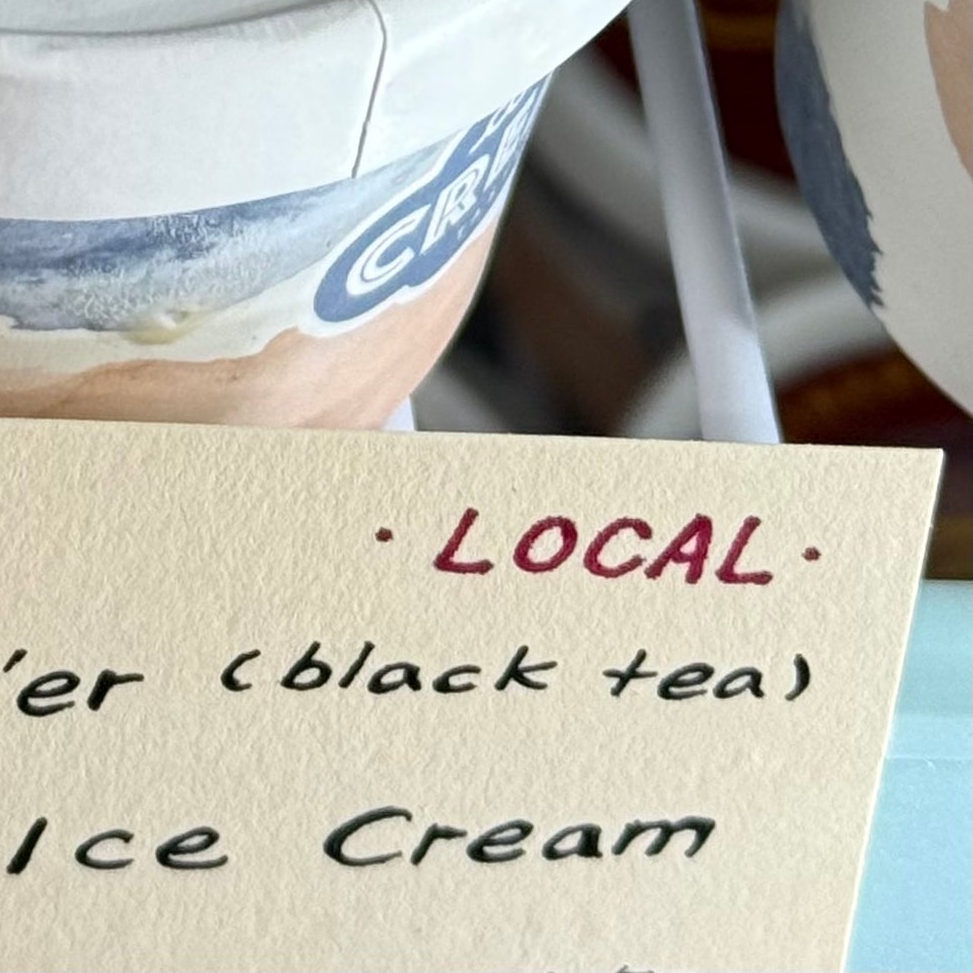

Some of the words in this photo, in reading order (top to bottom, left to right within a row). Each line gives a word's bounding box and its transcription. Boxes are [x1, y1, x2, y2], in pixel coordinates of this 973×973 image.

[220, 641, 557, 695] (black
[602, 649, 812, 701] tea)
[6, 816, 229, 875] Ice
[322, 807, 716, 867] Cream
